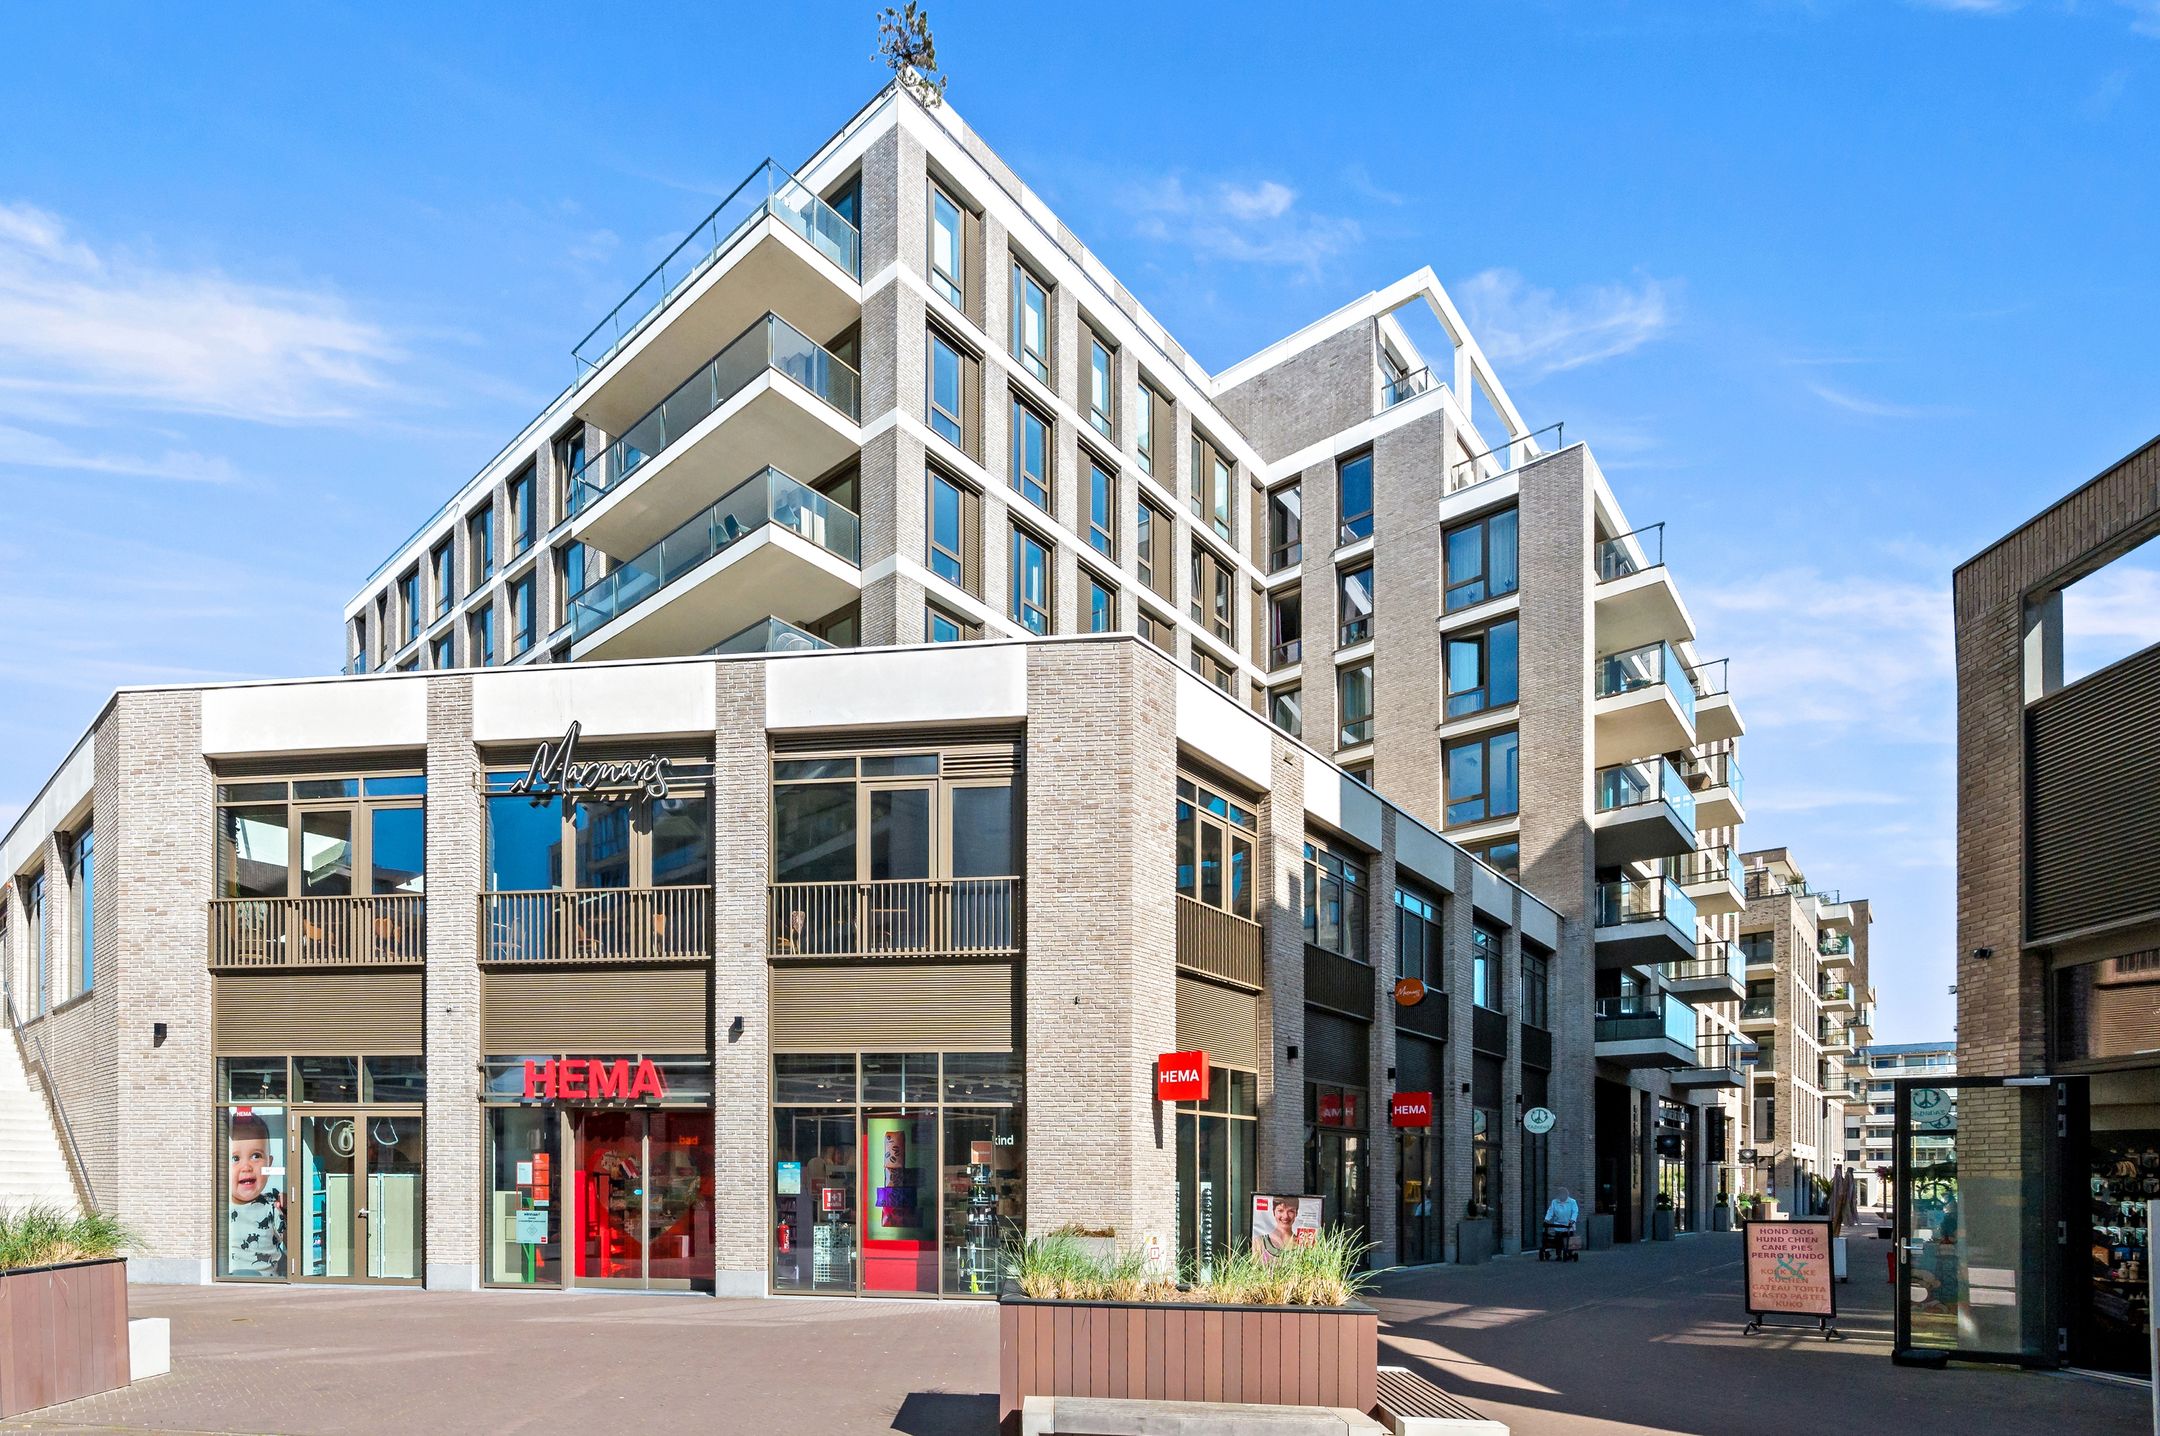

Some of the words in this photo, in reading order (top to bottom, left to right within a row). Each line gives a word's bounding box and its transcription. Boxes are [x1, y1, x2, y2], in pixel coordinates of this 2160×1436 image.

[510, 720, 672, 799] Marmaris
[524, 1059, 664, 1099] HEMA
[1160, 1069, 1200, 1083] HEMA
[1394, 1105, 1427, 1115] HEMA
[679, 1135, 698, 1145] bad
[1788, 1236, 1819, 1244] CHIEN
[1794, 1285, 1826, 1293] TORTA
[1752, 1292, 1787, 1300] CIASTO
